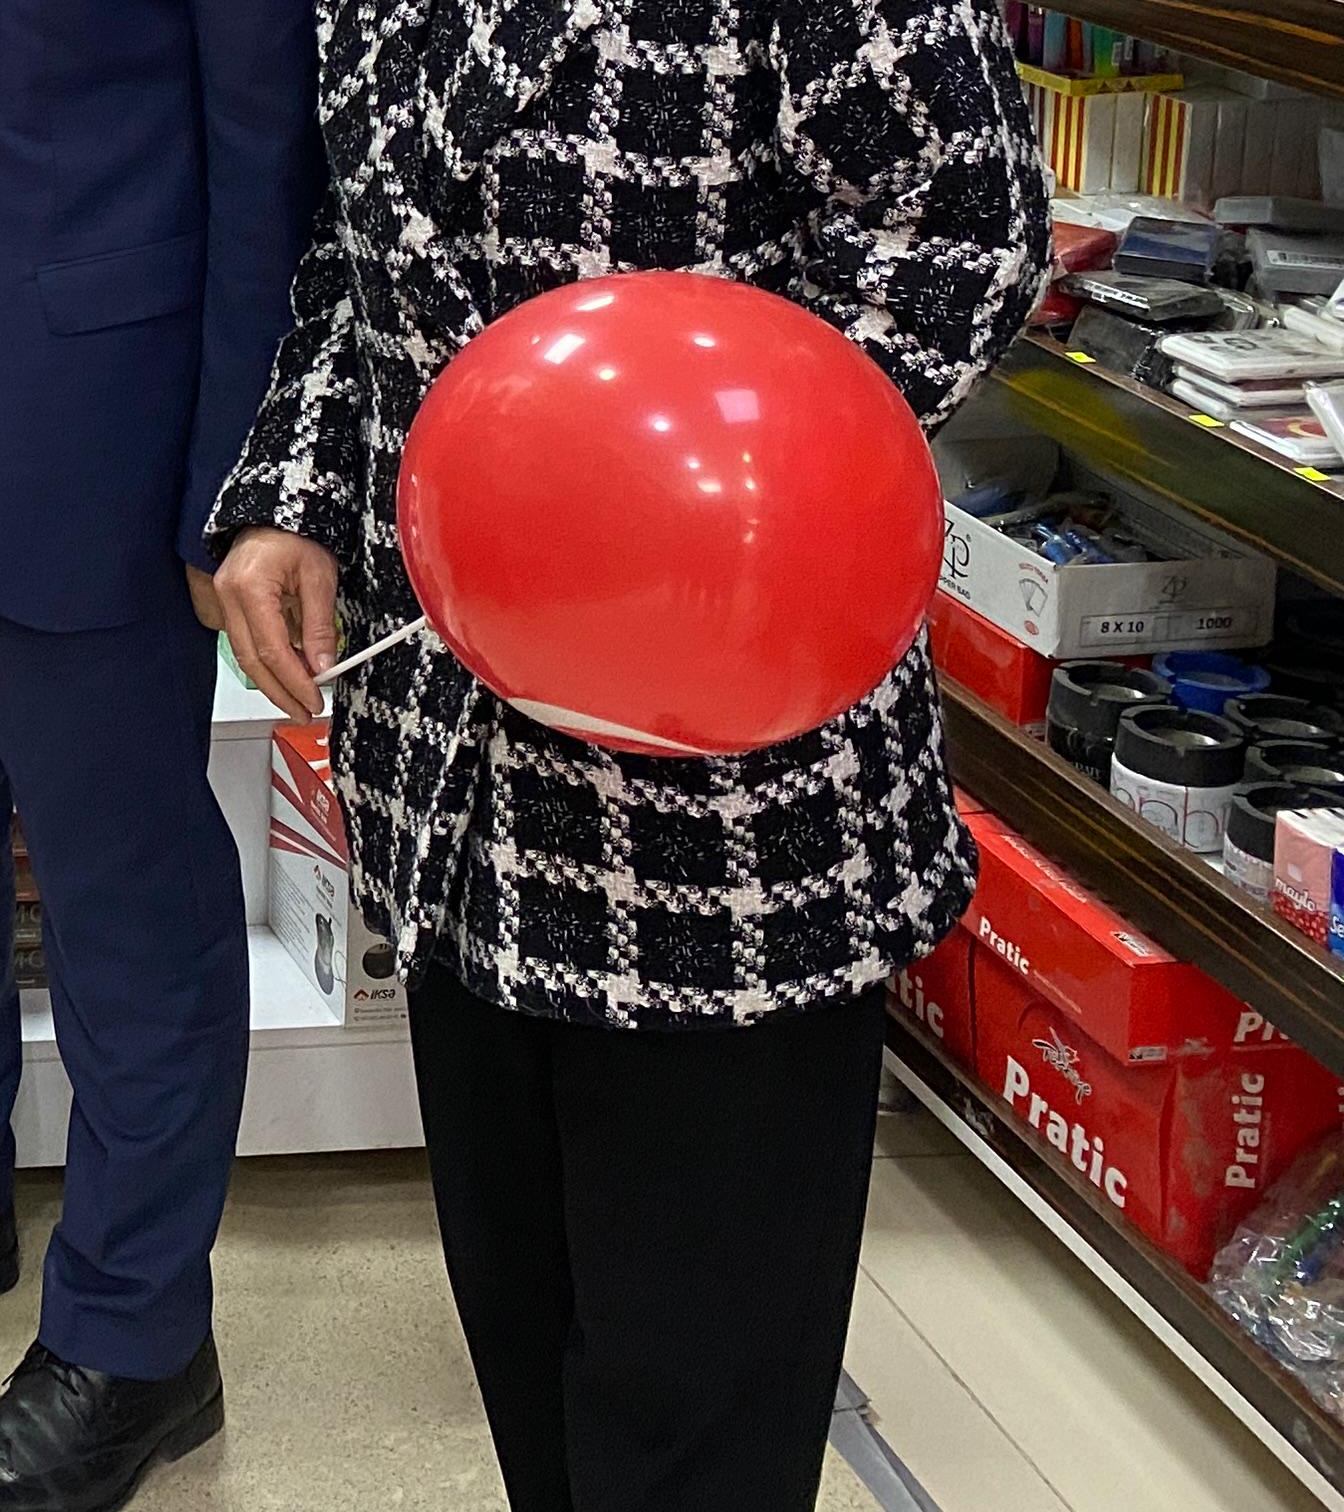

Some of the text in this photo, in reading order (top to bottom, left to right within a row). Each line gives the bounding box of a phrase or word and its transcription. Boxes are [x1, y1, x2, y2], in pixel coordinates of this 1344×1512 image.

[1101, 620, 1144, 634] 8 X 10
[1196, 617, 1233, 631] 1000
[979, 916, 1030, 975] Pratic
[1005, 1055, 1127, 1209] Pratic
[1224, 1073, 1264, 1188] Pratic
